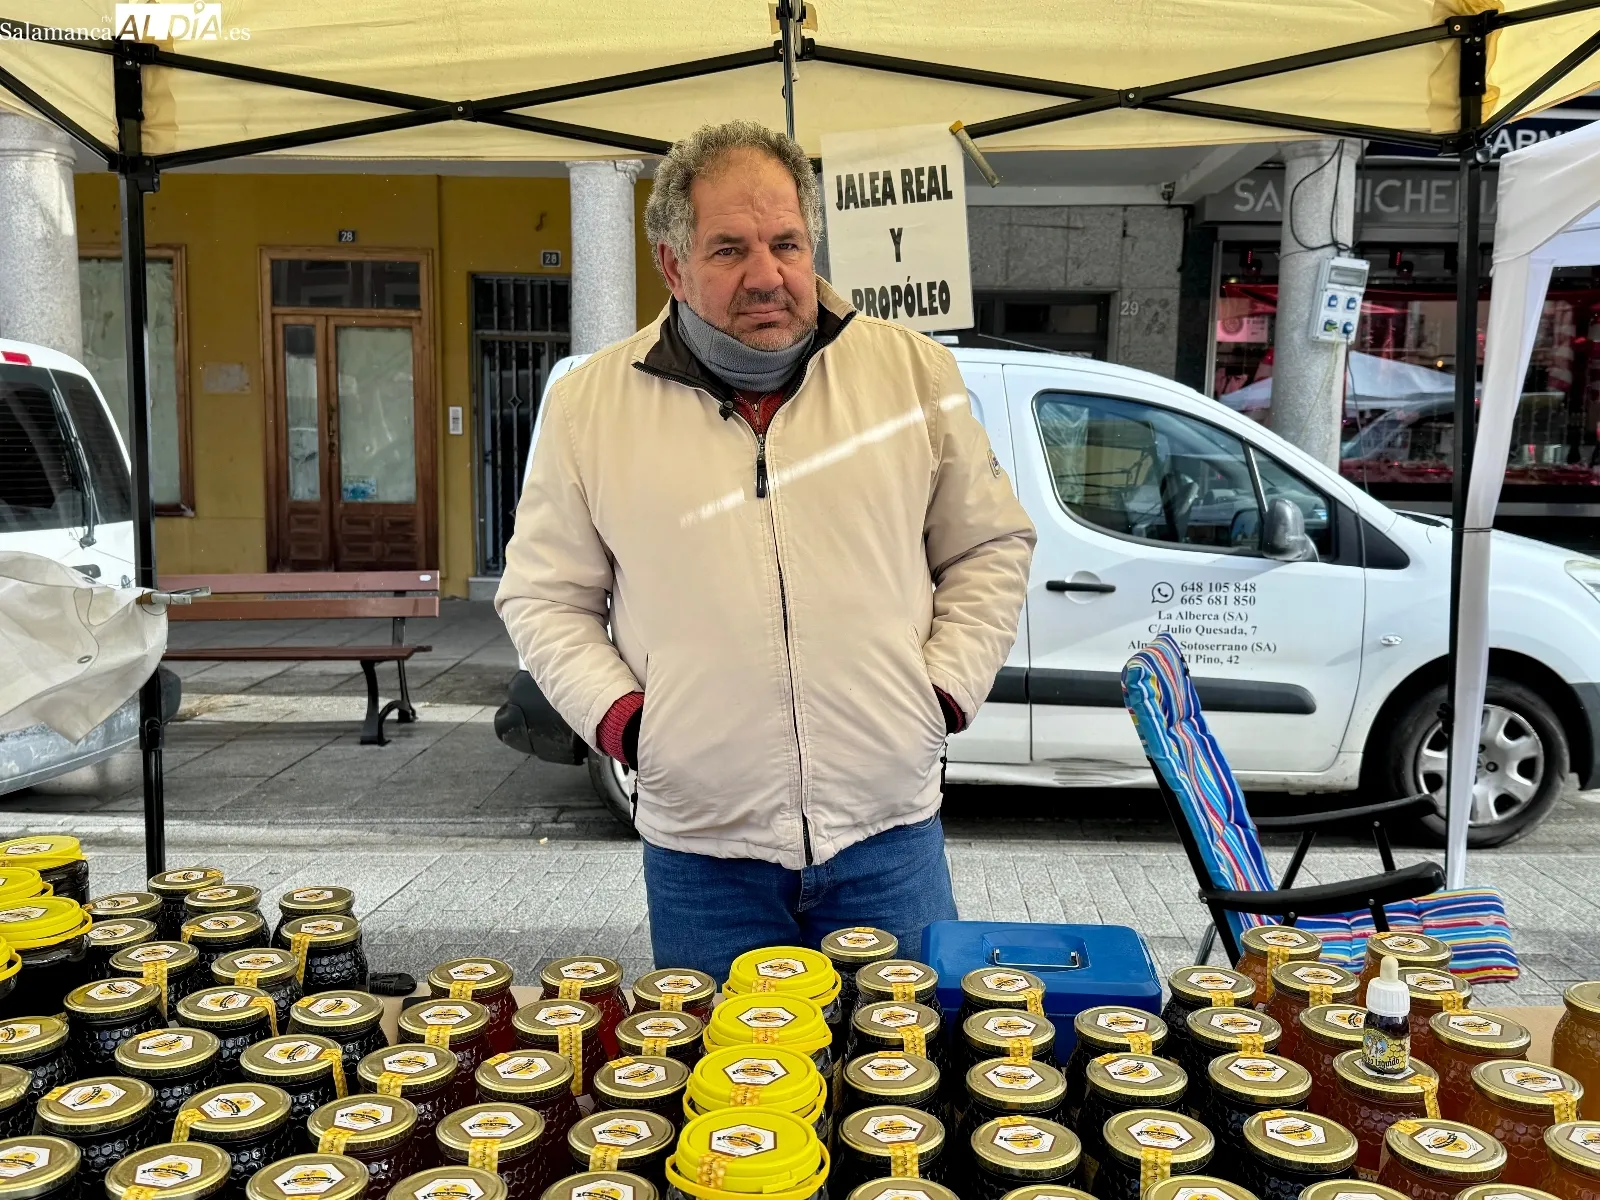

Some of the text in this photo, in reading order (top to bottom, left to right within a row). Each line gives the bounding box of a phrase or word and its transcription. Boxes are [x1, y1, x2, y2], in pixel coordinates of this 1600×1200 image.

[835, 164, 953, 211] JALEA REAL
[341, 231, 353, 242] 28
[888, 226, 903, 263] Y
[544, 253, 557, 264] 28
[851, 275, 951, 321] PROPÓLEO
[1120, 301, 1139, 315] 29
[1180, 582, 1256, 593] 648 105 848
[1180, 595, 1256, 606] 665 681 850
[1158, 610, 1249, 622] La Alberca (SA)
[1163, 624, 1192, 634] Julio
[1195, 625, 1247, 636] Quesada,
[1250, 625, 1258, 635] 7
[1180, 640, 1248, 652] Sotoserrano
[1250, 641, 1277, 654] (SA)
[1195, 654, 1224, 665] Pino,
[1226, 655, 1240, 665] 42
